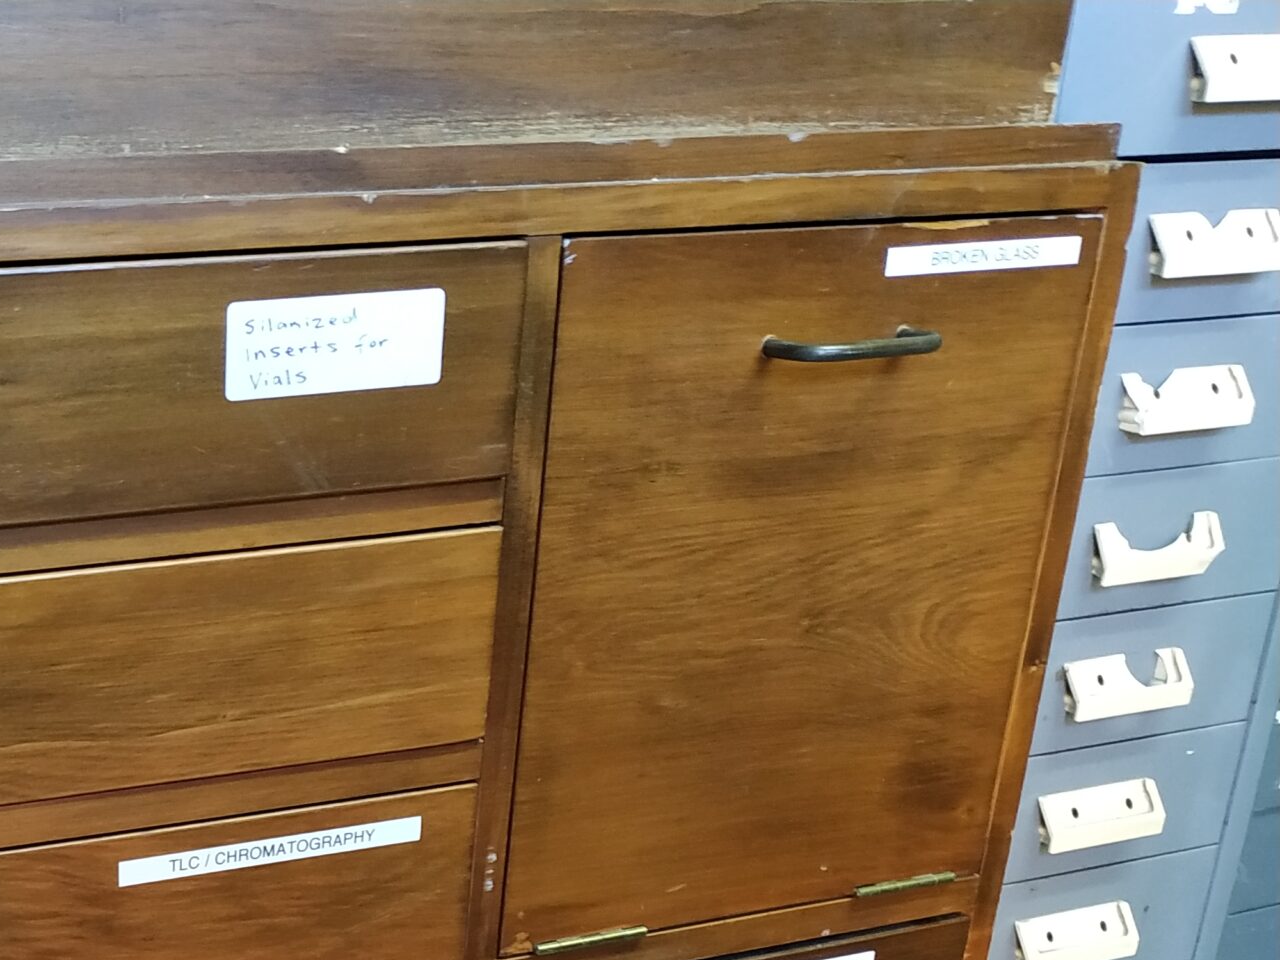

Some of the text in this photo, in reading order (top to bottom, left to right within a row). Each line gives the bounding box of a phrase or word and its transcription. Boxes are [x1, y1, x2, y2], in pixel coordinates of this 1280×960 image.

[931, 245, 1040, 266] BROKEN GLASS
[245, 334, 389, 362] Inserts for
[249, 369, 308, 390] Vials
[169, 856, 201, 873] TLC
[215, 829, 376, 866] CHROMATOGRAPHY
